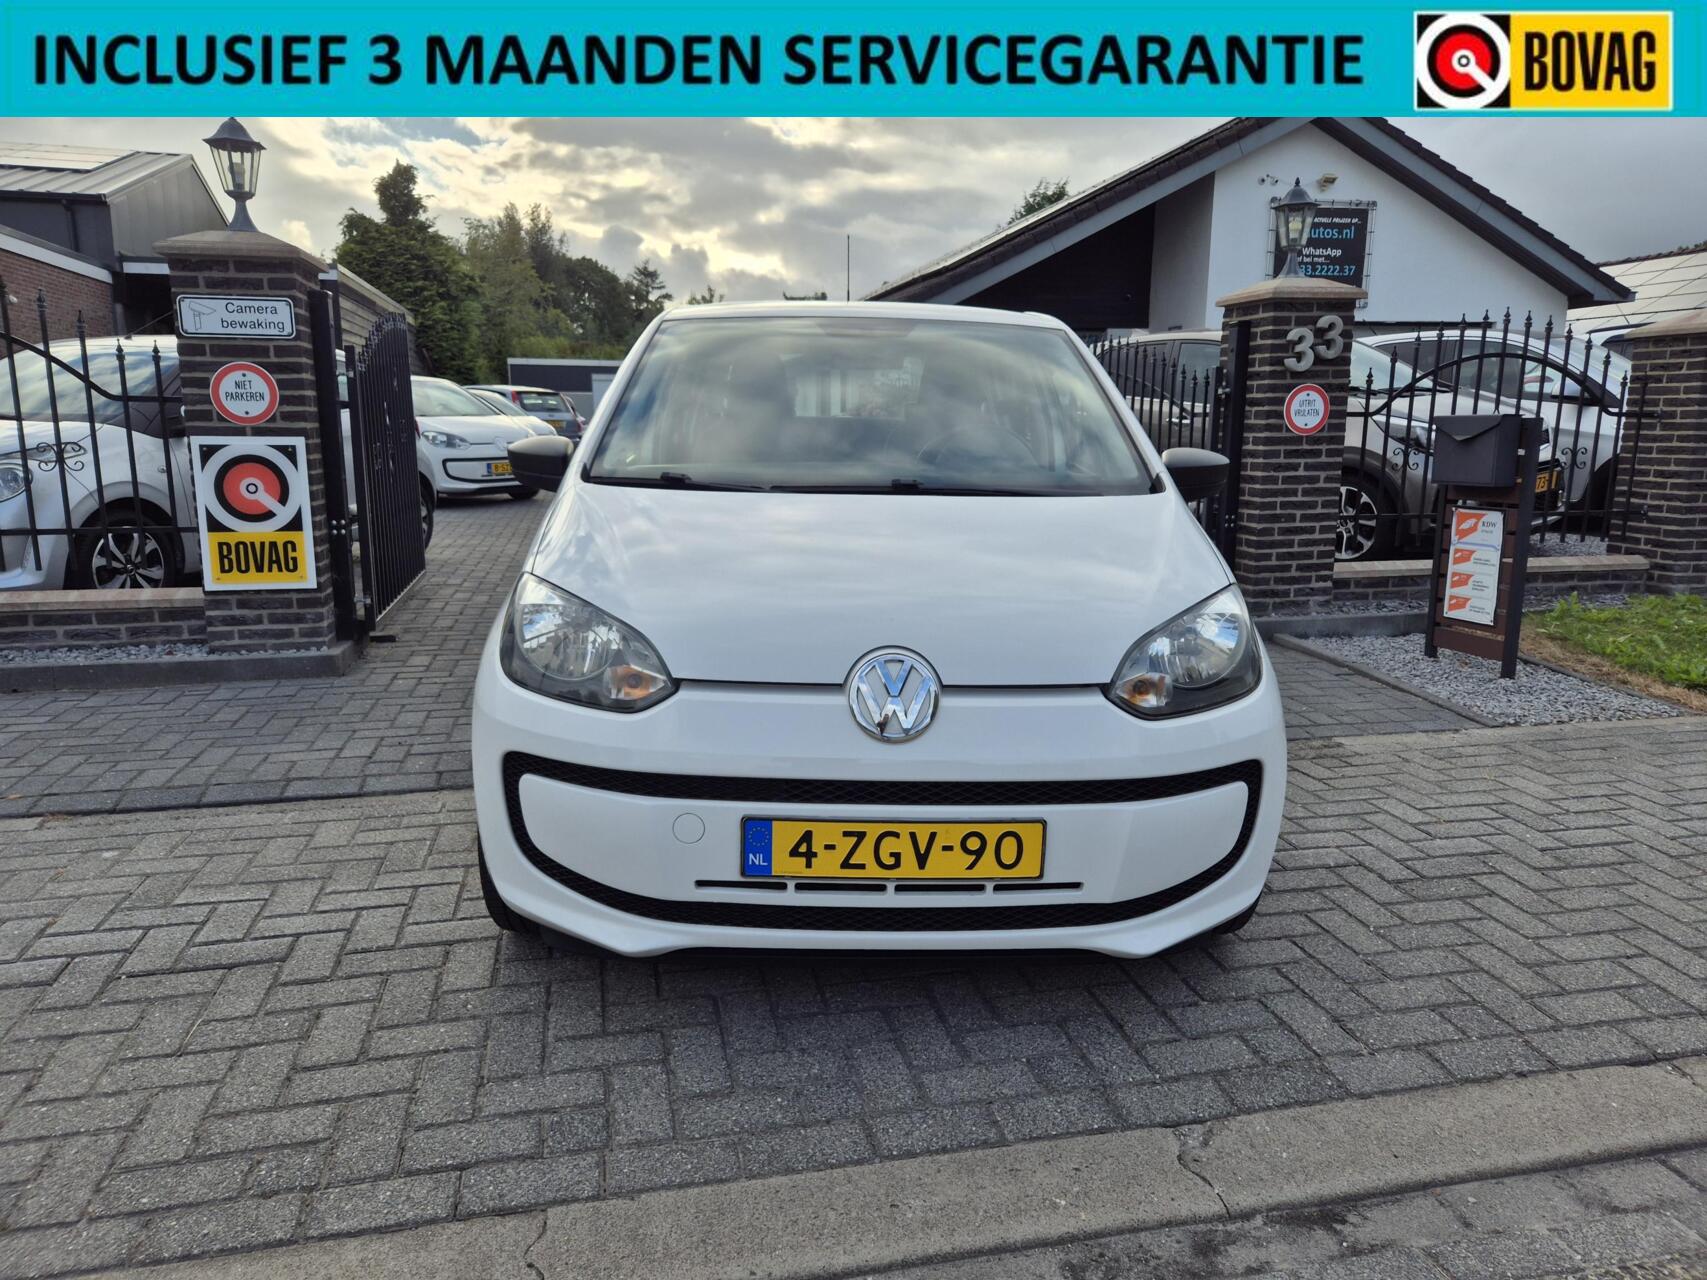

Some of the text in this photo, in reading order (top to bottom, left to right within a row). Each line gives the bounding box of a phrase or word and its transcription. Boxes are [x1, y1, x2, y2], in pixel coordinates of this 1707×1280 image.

[1302, 247, 1342, 257] WhatsApp
[225, 301, 278, 315] Camera
[221, 318, 285, 333] bewaking
[1284, 315, 1344, 372] 33
[234, 380, 252, 390] NIET
[225, 391, 265, 402] PARKEREN
[1298, 399, 1316, 408] UITRIT
[217, 540, 299, 574] BOVAG
[749, 829, 1024, 871] NL 4-ZGV-90
